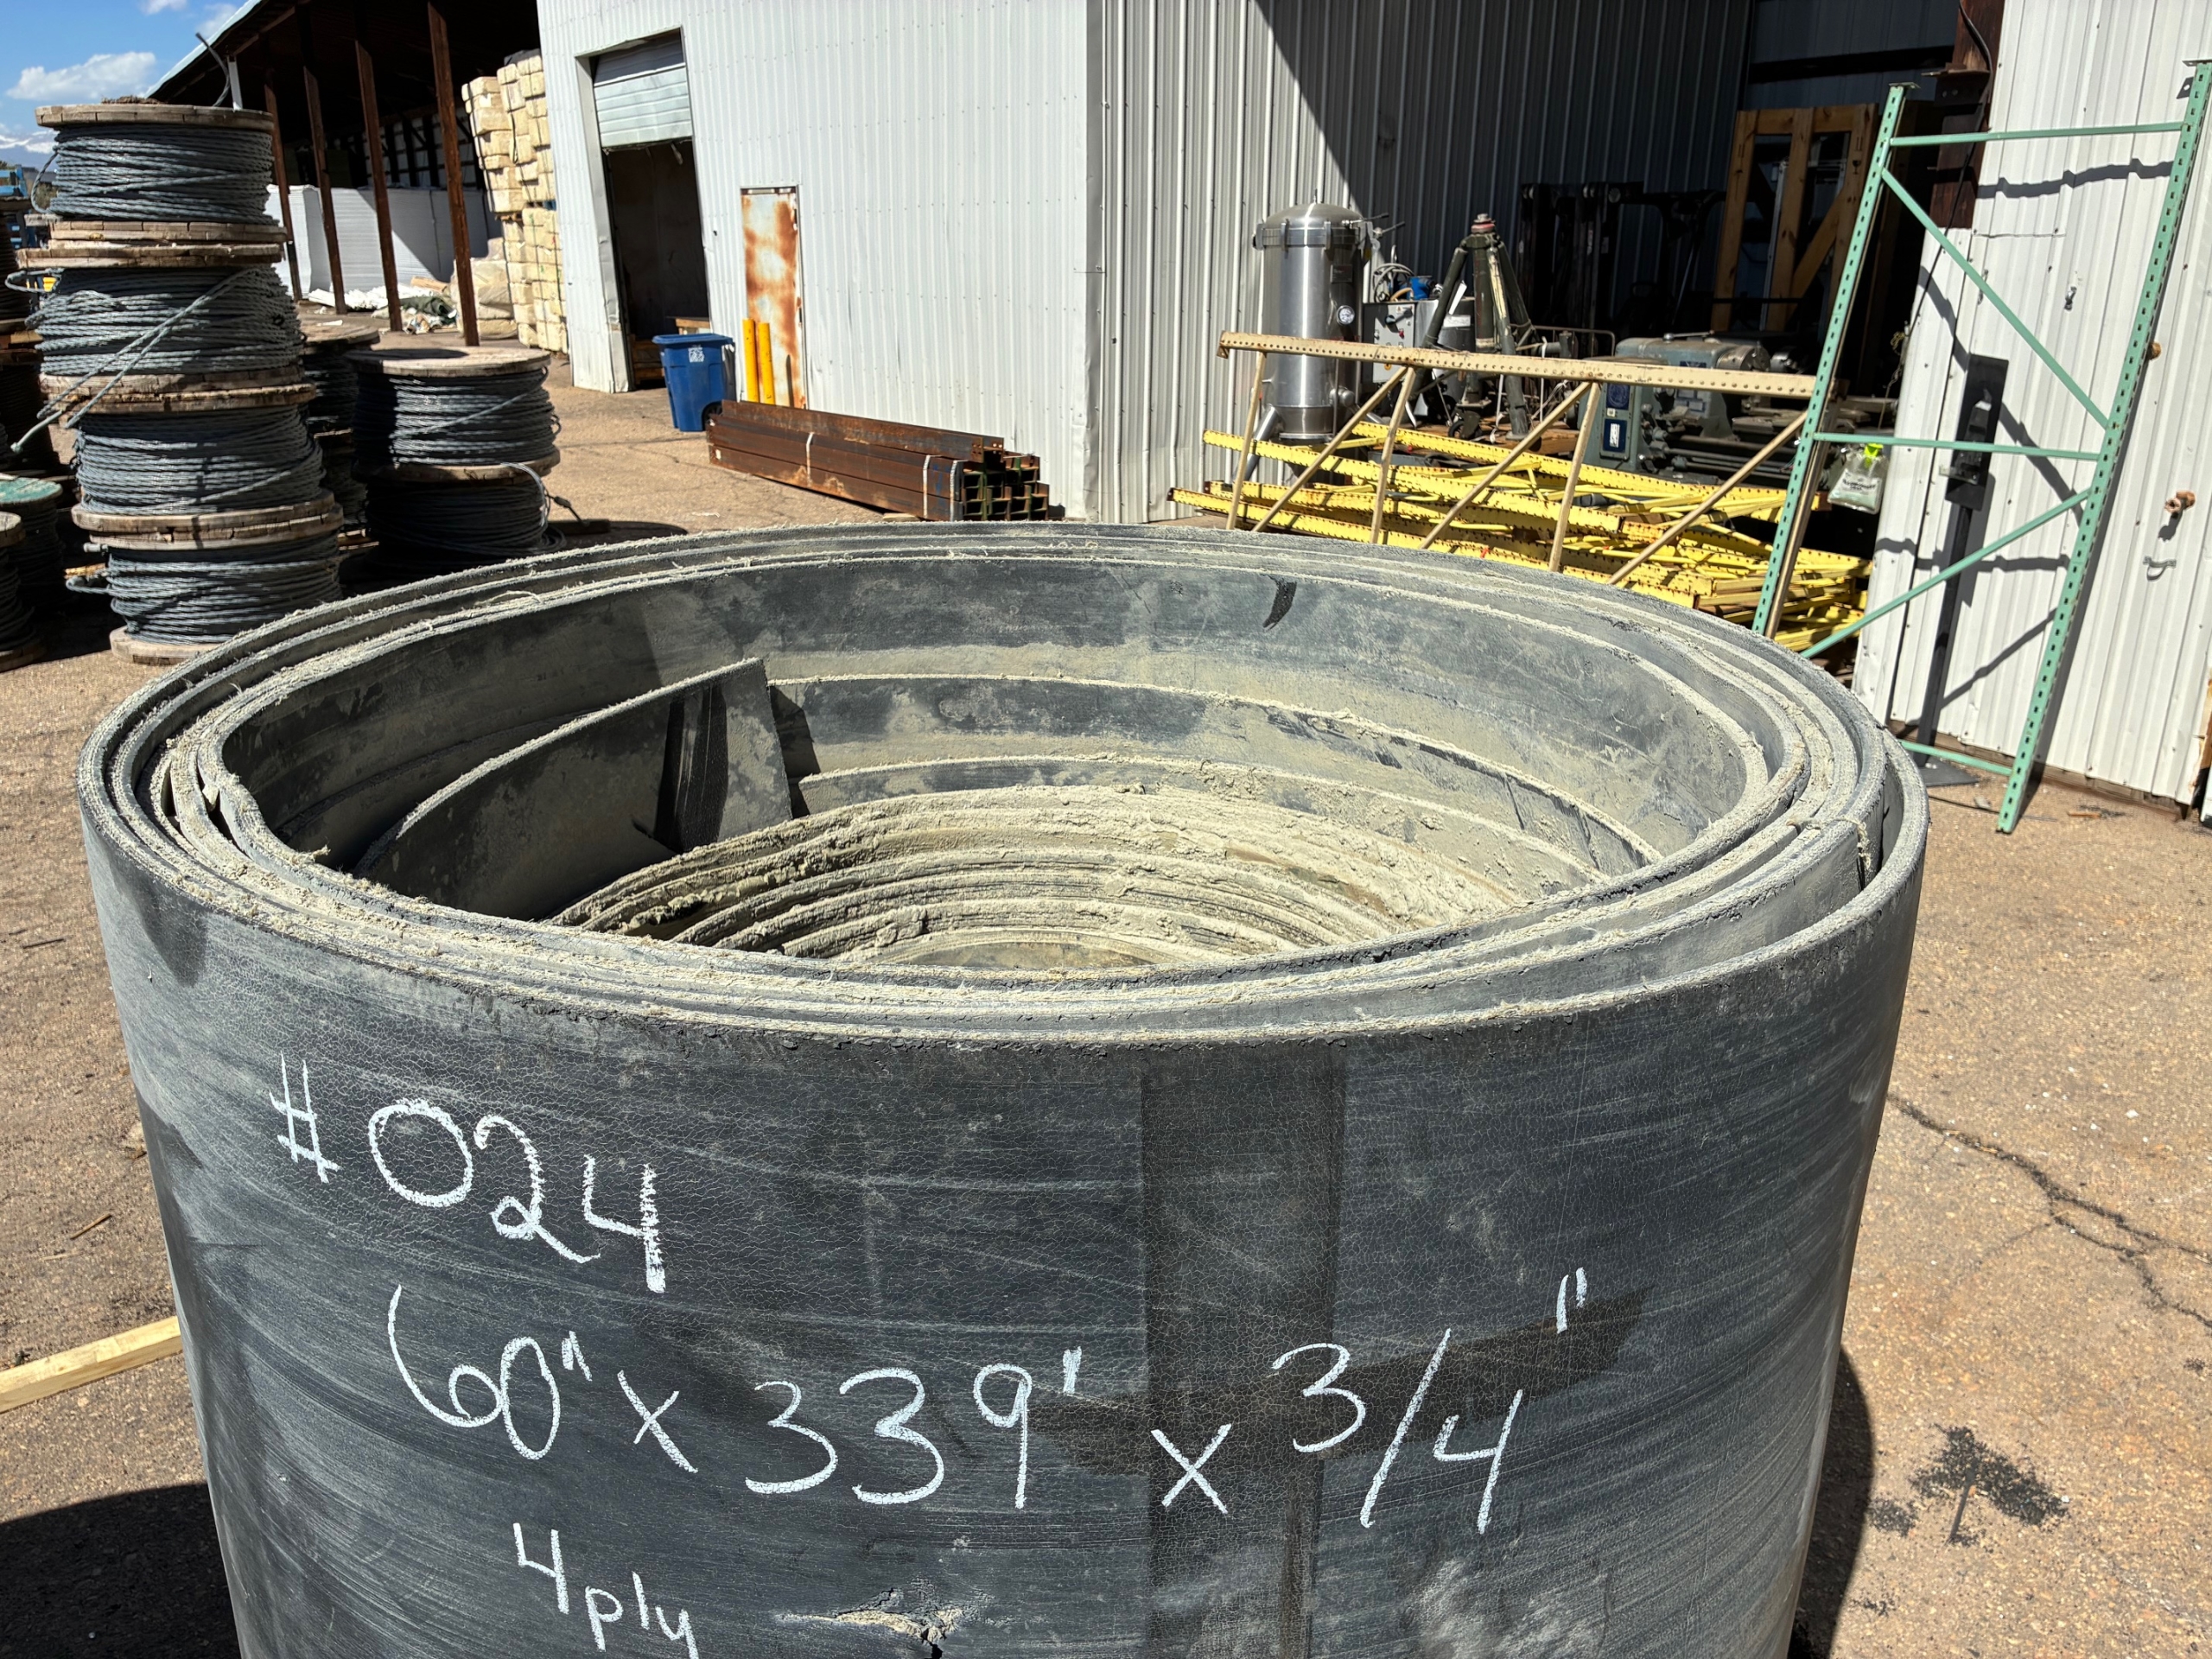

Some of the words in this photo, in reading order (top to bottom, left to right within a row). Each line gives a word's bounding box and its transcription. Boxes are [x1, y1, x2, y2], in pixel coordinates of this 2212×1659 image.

[269, 1052, 666, 1294] #024
[1272, 1266, 1588, 1535] 3/4"
[512, 1522, 570, 1616] 4
[585, 1570, 700, 1659] ply
